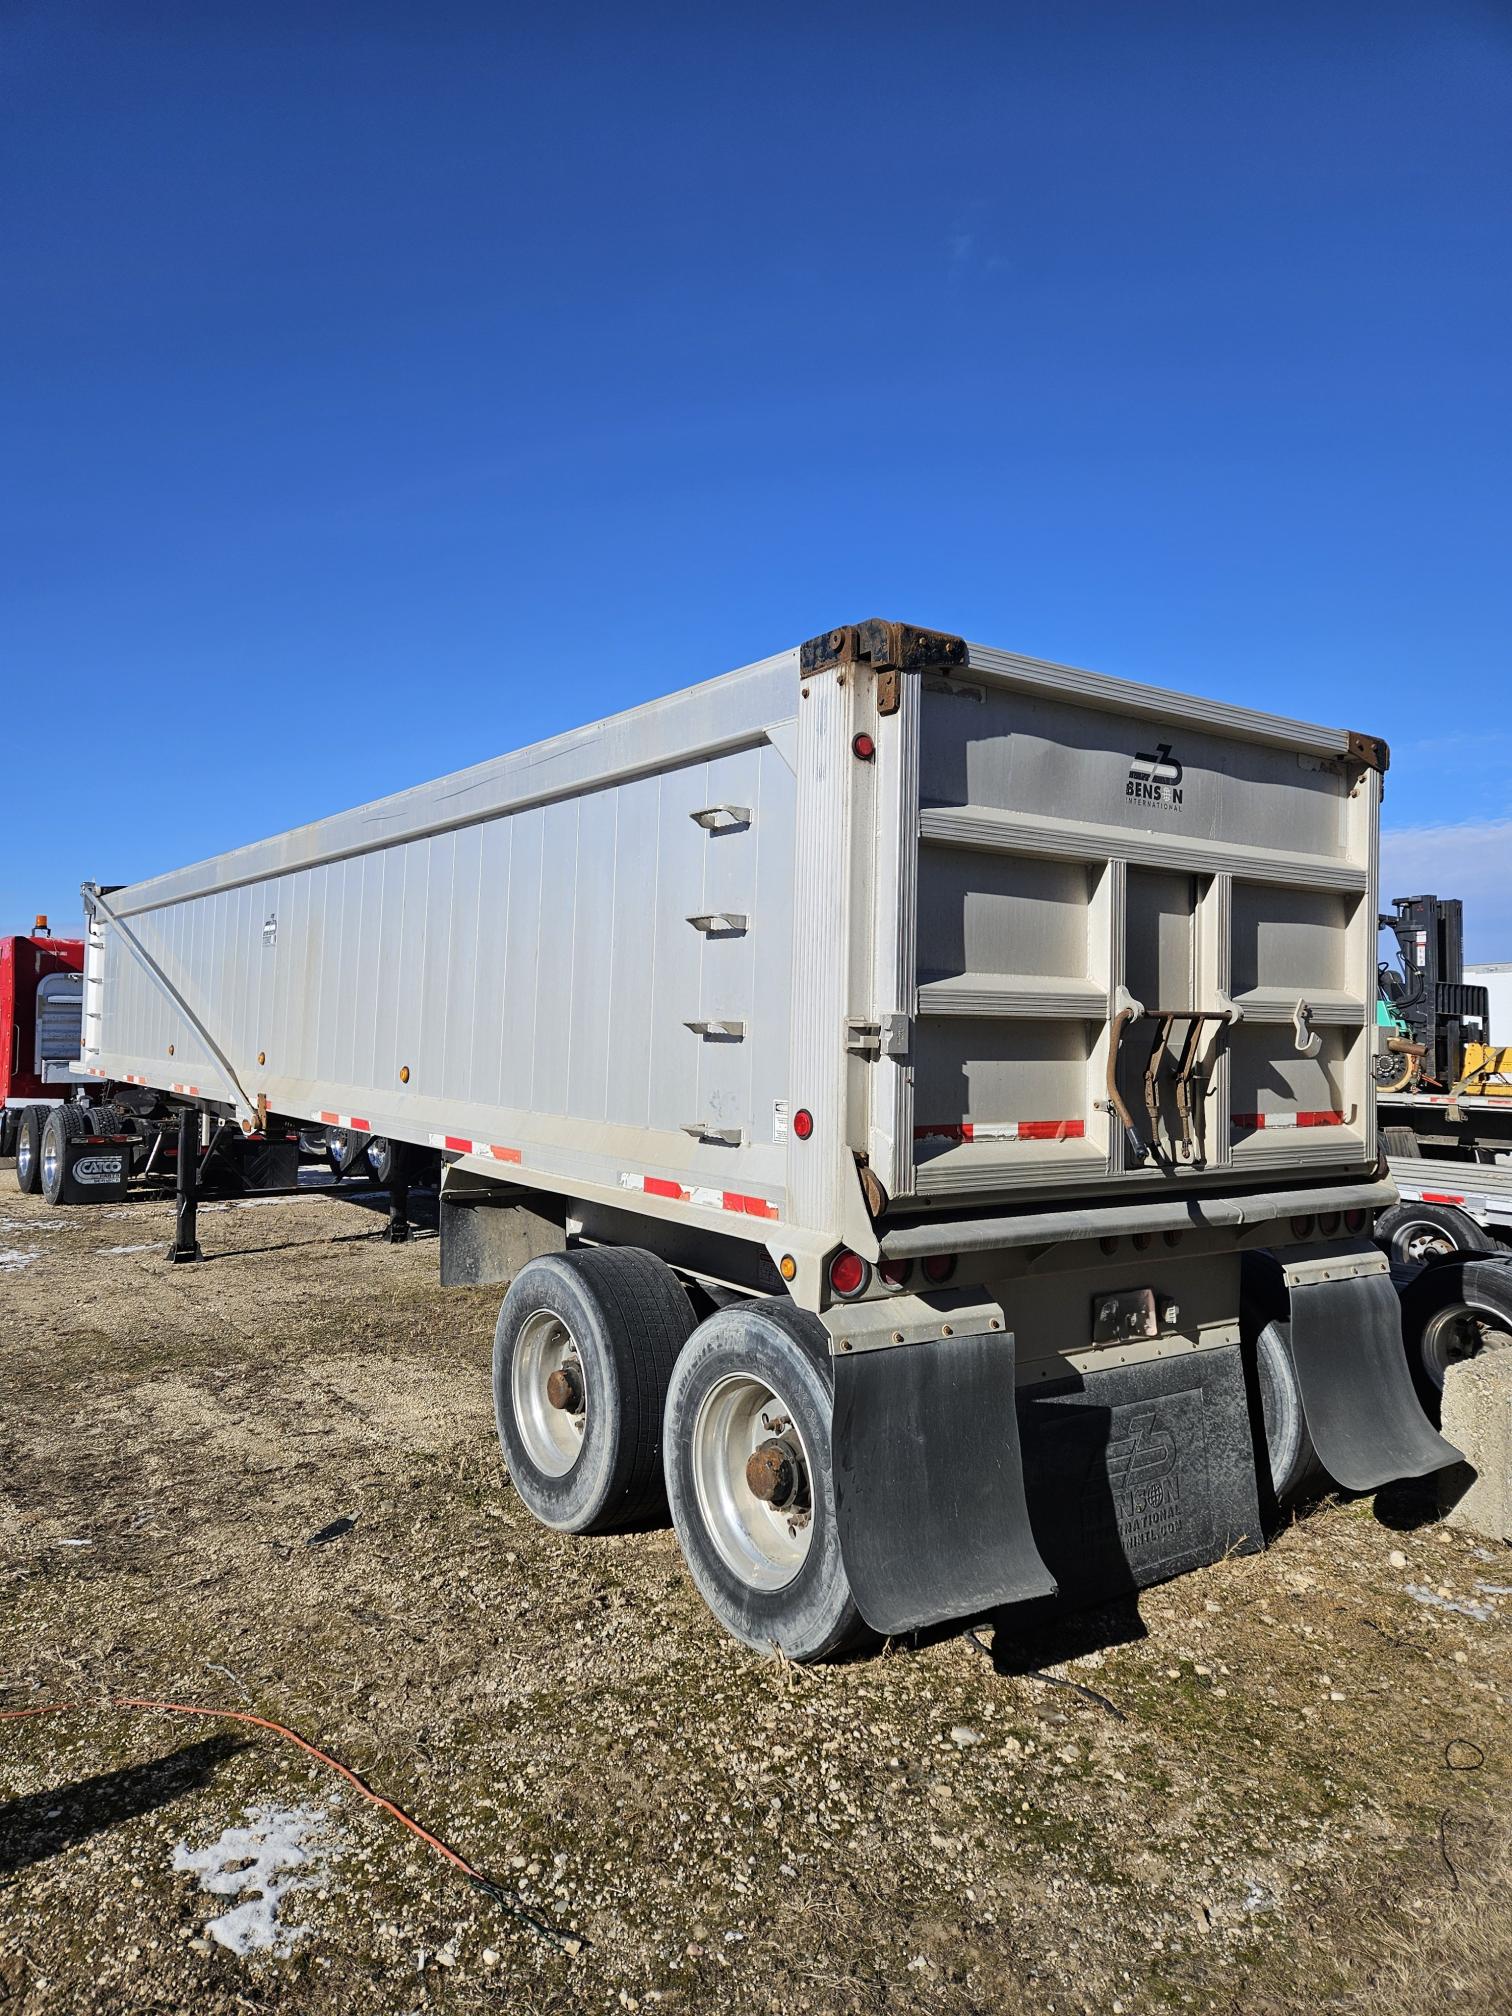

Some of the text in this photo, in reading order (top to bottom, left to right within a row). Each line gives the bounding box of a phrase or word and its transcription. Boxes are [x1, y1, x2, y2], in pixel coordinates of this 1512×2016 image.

[1126, 781, 1183, 804] BENSON
[1125, 797, 1183, 813] INTERNATIONAL
[81, 1161, 122, 1173] CATCO
